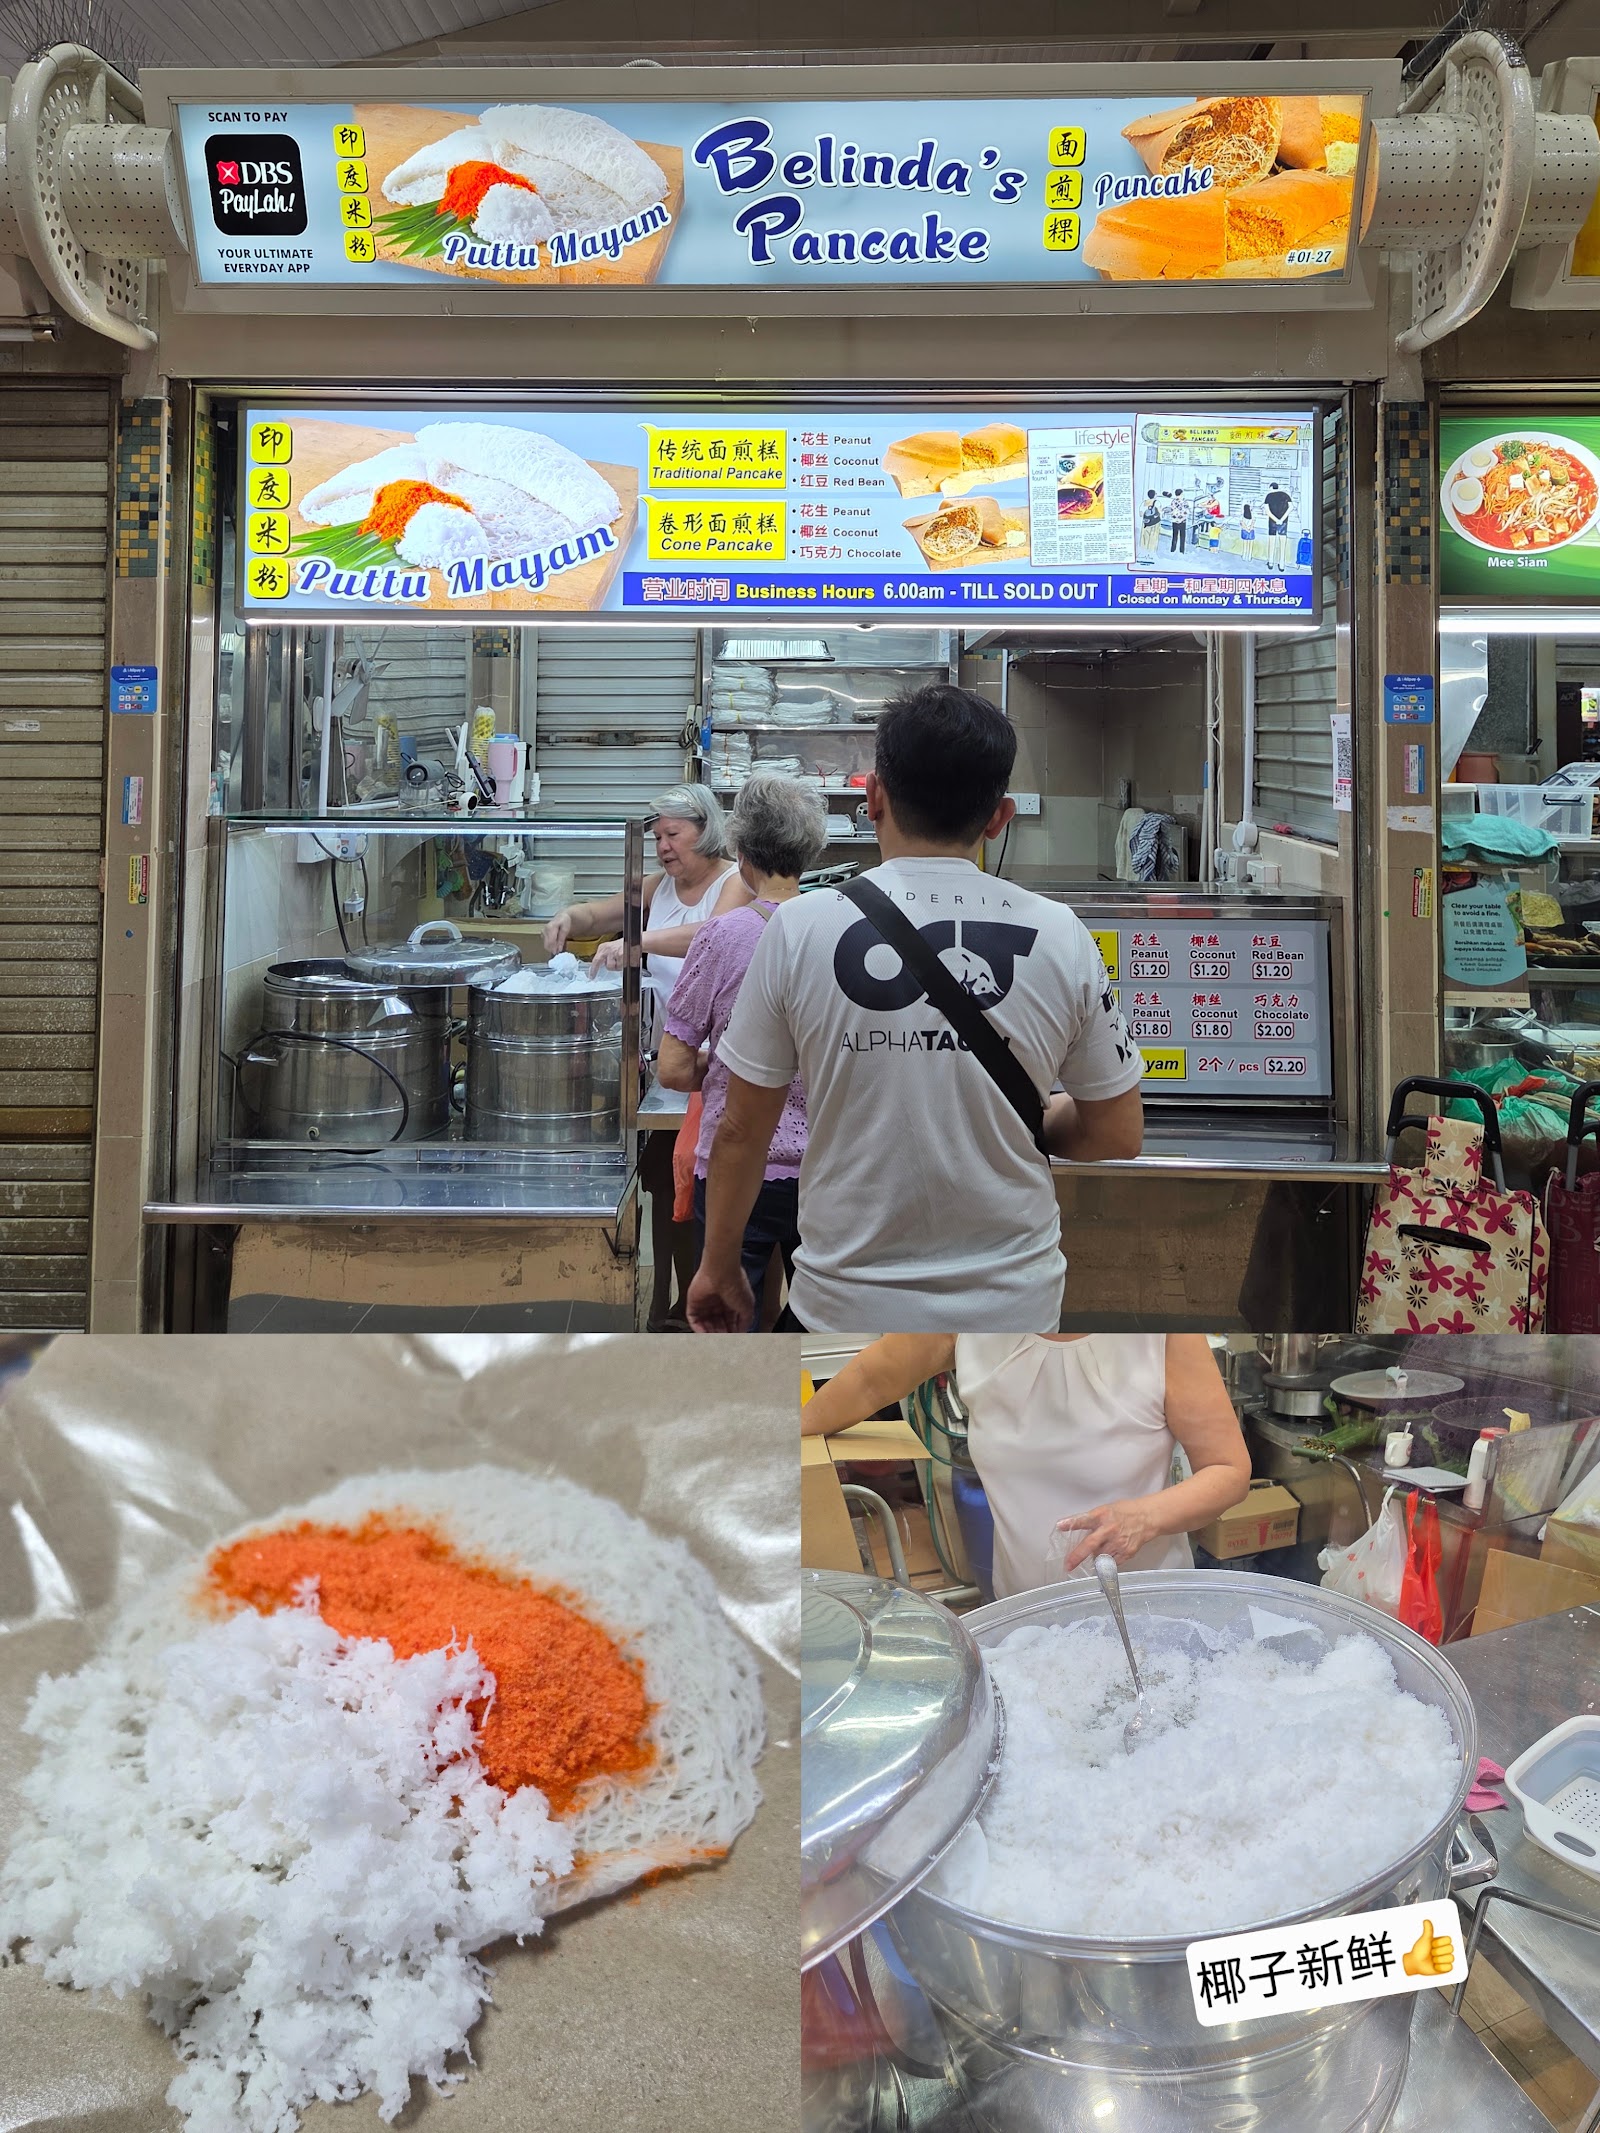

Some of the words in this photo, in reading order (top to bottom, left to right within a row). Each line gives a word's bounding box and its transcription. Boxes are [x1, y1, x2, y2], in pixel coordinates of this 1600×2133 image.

[208, 112, 244, 123] SCAN
[246, 112, 260, 123] TO
[262, 112, 288, 123] PAY
[697, 116, 1025, 204] Belinda's
[242, 162, 293, 185] DBS
[1094, 164, 1214, 206] Pancake
[338, 127, 371, 258] 印度米粉
[219, 188, 295, 218] PayLah!
[737, 195, 989, 262] Pancake
[445, 233, 538, 267] Puttu
[552, 206, 669, 266] Mayam
[217, 248, 251, 260] YOUR
[254, 248, 313, 260] ULTIMATE
[1287, 250, 1331, 265] #01-27
[224, 262, 283, 274] EVERYDAY
[286, 262, 310, 273] APP
[800, 432, 829, 446] 花生
[834, 435, 871, 445] Peanut
[1074, 429, 1130, 449] lifestyle
[656, 439, 780, 463] 传统面煎糕
[800, 453, 829, 467] 椰丝
[833, 456, 879, 466] Coconut
[652, 467, 722, 479] Traditional
[727, 467, 783, 480] Pancake
[800, 475, 829, 488] 红豆
[833, 477, 854, 487] Red
[858, 477, 885, 487] Bean
[252, 427, 284, 592] 印度米粉
[800, 504, 829, 518] 花生
[833, 507, 871, 517] Peanut
[657, 512, 778, 535] 卷形面煎糕
[799, 525, 828, 539] 椰丝
[833, 528, 878, 538] Coconut
[661, 538, 701, 551] Cone
[706, 538, 772, 552] Pancake
[799, 546, 842, 560] 巧克力
[847, 549, 902, 559] Chocolate
[300, 560, 430, 599] Puttu
[448, 527, 615, 595] Mayam
[1487, 557, 1515, 567] Mee
[1517, 557, 1548, 567] Siam
[641, 578, 731, 601] 营业时间
[736, 584, 817, 599] Business
[823, 584, 875, 600] Hours
[883, 583, 945, 600] 6.00am
[961, 583, 999, 600] TILL
[1003, 583, 1054, 600] SOLD
[1058, 583, 1098, 600] OUT
[1134, 578, 1287, 594] 星期一和星期四休息
[1118, 594, 1160, 604] Closed
[1163, 596, 1178, 604] on
[1182, 595, 1229, 606] Monday
[1233, 595, 1242, 604] &
[1245, 595, 1302, 607] Thursday
[837, 891, 1012, 908] SDERIA
[1132, 933, 1161, 947] 花生
[1190, 934, 1220, 947] 椰丝
[1252, 935, 1281, 948] 红豆
[1131, 950, 1169, 959] Peanut
[1190, 951, 1236, 960] Coconut
[1252, 951, 1274, 960] Red
[1277, 951, 1304, 960] Bean
[1133, 963, 1167, 976] $1.20
[1194, 963, 1228, 976] $1.20
[1256, 964, 1290, 977] $1.20
[1133, 993, 1162, 1005] 花生
[1192, 993, 1222, 1006] 椰丝
[1254, 994, 1299, 1007] 巧克力
[1133, 1009, 1170, 1018] Peanut
[1192, 1010, 1238, 1019] Coconut
[1254, 1010, 1309, 1020] Chocolate
[1135, 1022, 1168, 1035] $1.80
[1195, 1022, 1229, 1036] $1.80
[1257, 1023, 1292, 1037] $2.00
[841, 1030, 1011, 1052] ALPHATA
[1145, 1058, 1179, 1073] yam
[1198, 1058, 1223, 1072] 2个
[1228, 1059, 1235, 1072] /
[1239, 1062, 1259, 1073] pcs
[1268, 1059, 1303, 1073] $2.20
